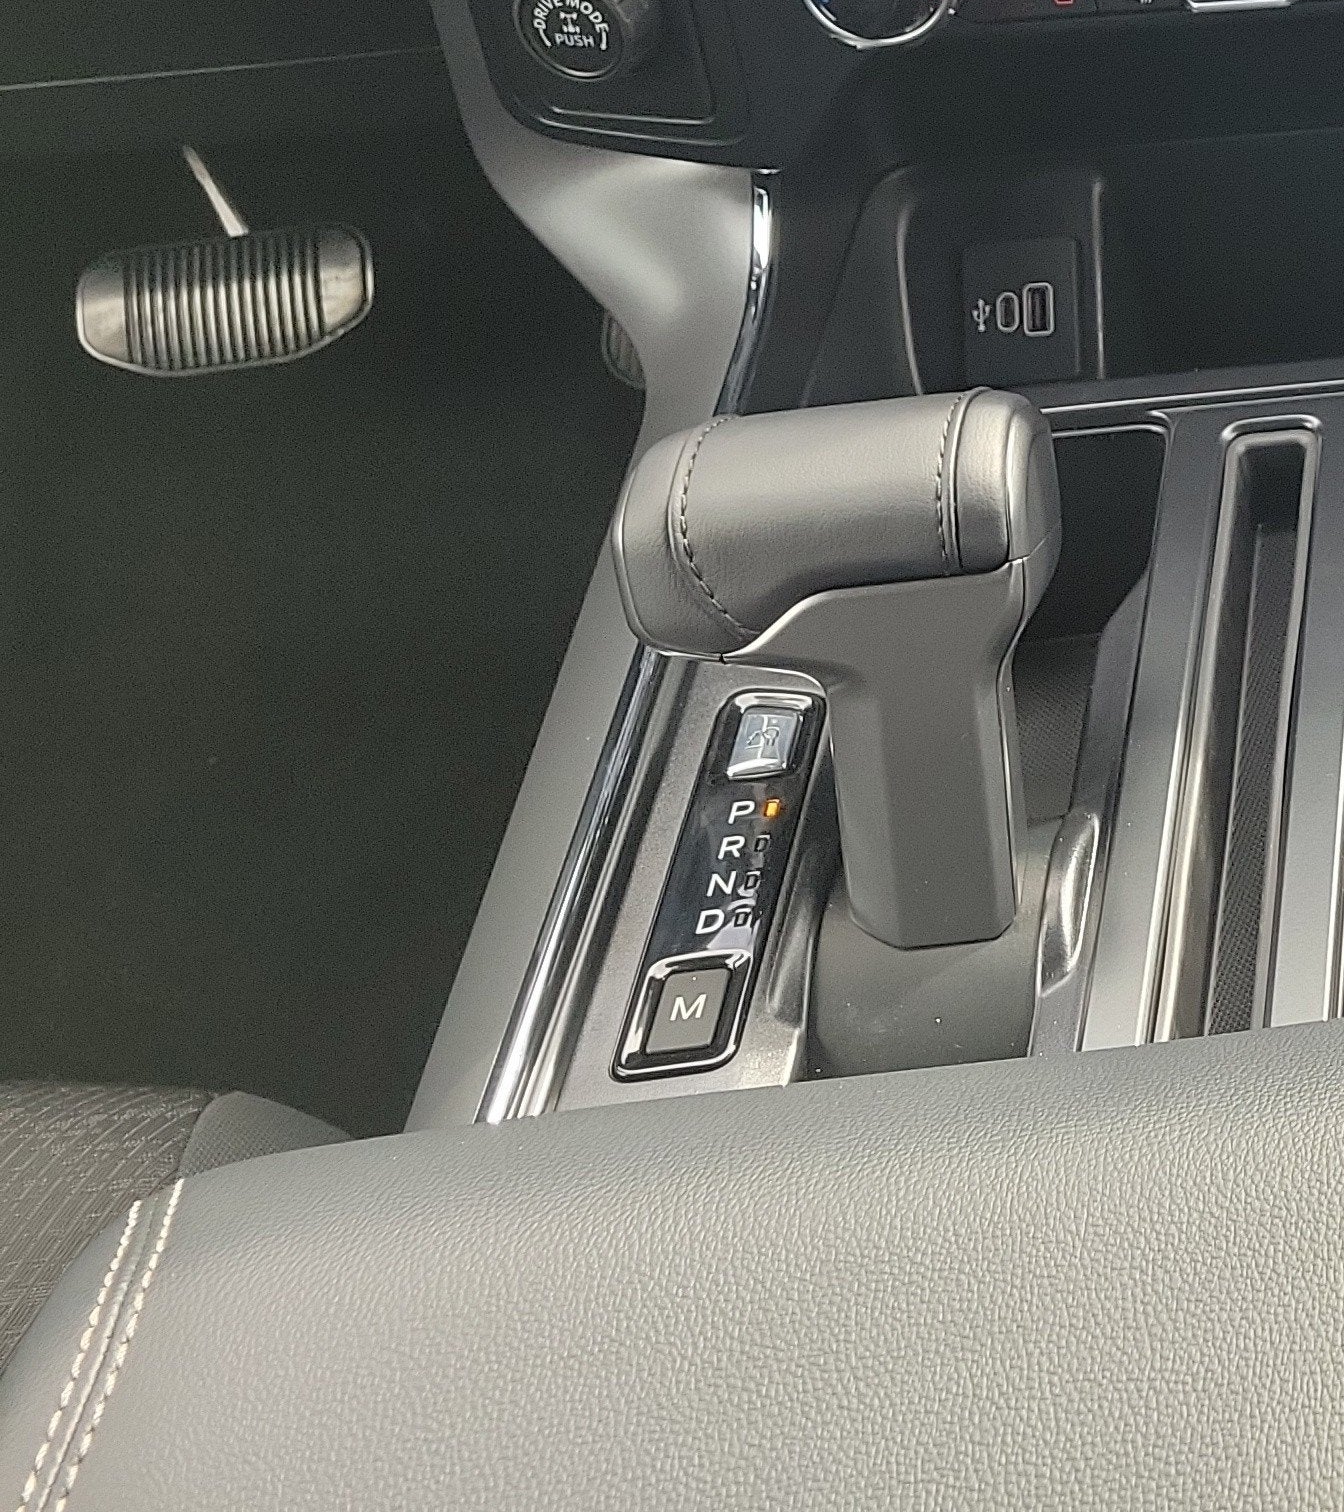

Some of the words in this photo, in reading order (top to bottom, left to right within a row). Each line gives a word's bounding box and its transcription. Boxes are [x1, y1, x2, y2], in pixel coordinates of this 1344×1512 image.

[554, 32, 595, 48] PUSH
[728, 800, 755, 825] P
[717, 834, 745, 860] R
[706, 871, 737, 897] N
[695, 908, 725, 935] D
[670, 994, 707, 1021] M
